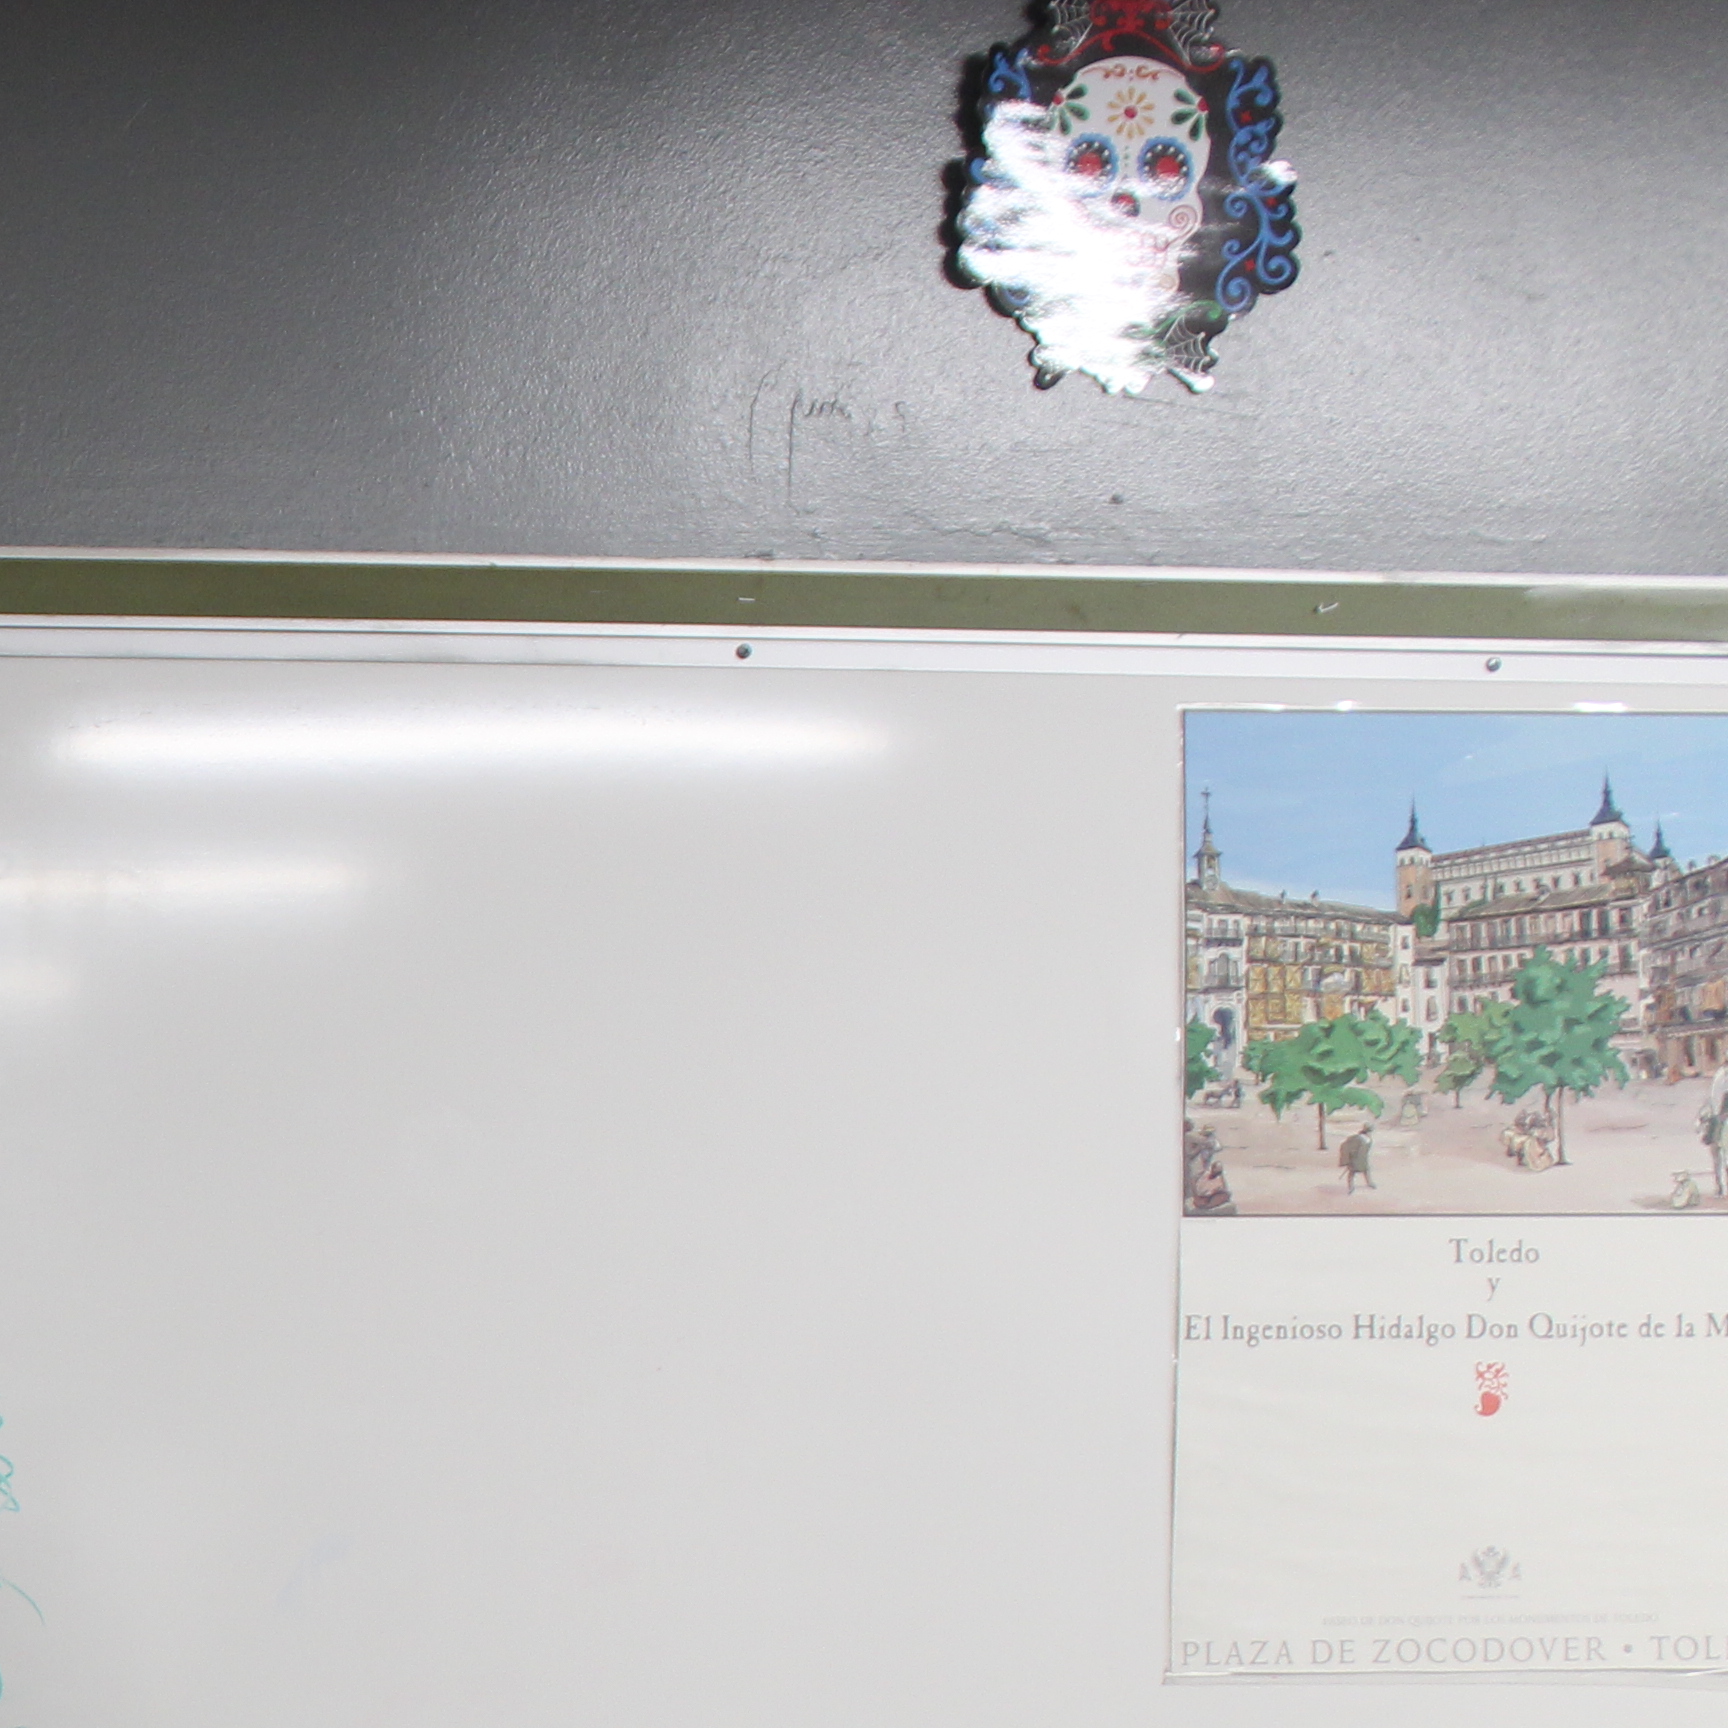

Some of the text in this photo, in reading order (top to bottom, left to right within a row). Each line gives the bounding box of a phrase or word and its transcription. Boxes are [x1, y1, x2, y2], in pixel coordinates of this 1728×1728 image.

[1448, 1237, 1540, 1264] Toledo
[1486, 1276, 1501, 1301] y
[1184, 1314, 1212, 1341] El
[1221, 1314, 1343, 1348] Ingenioso
[1353, 1313, 1456, 1347] Hidalgo
[1465, 1312, 1519, 1339] Don
[1528, 1311, 1629, 1347] Quijote
[1638, 1312, 1665, 1338] de
[1675, 1312, 1696, 1338] la
[1181, 1640, 1294, 1666] PLAZA
[1311, 1638, 1356, 1665] DE
[1372, 1636, 1606, 1664] ZOCODOVER
